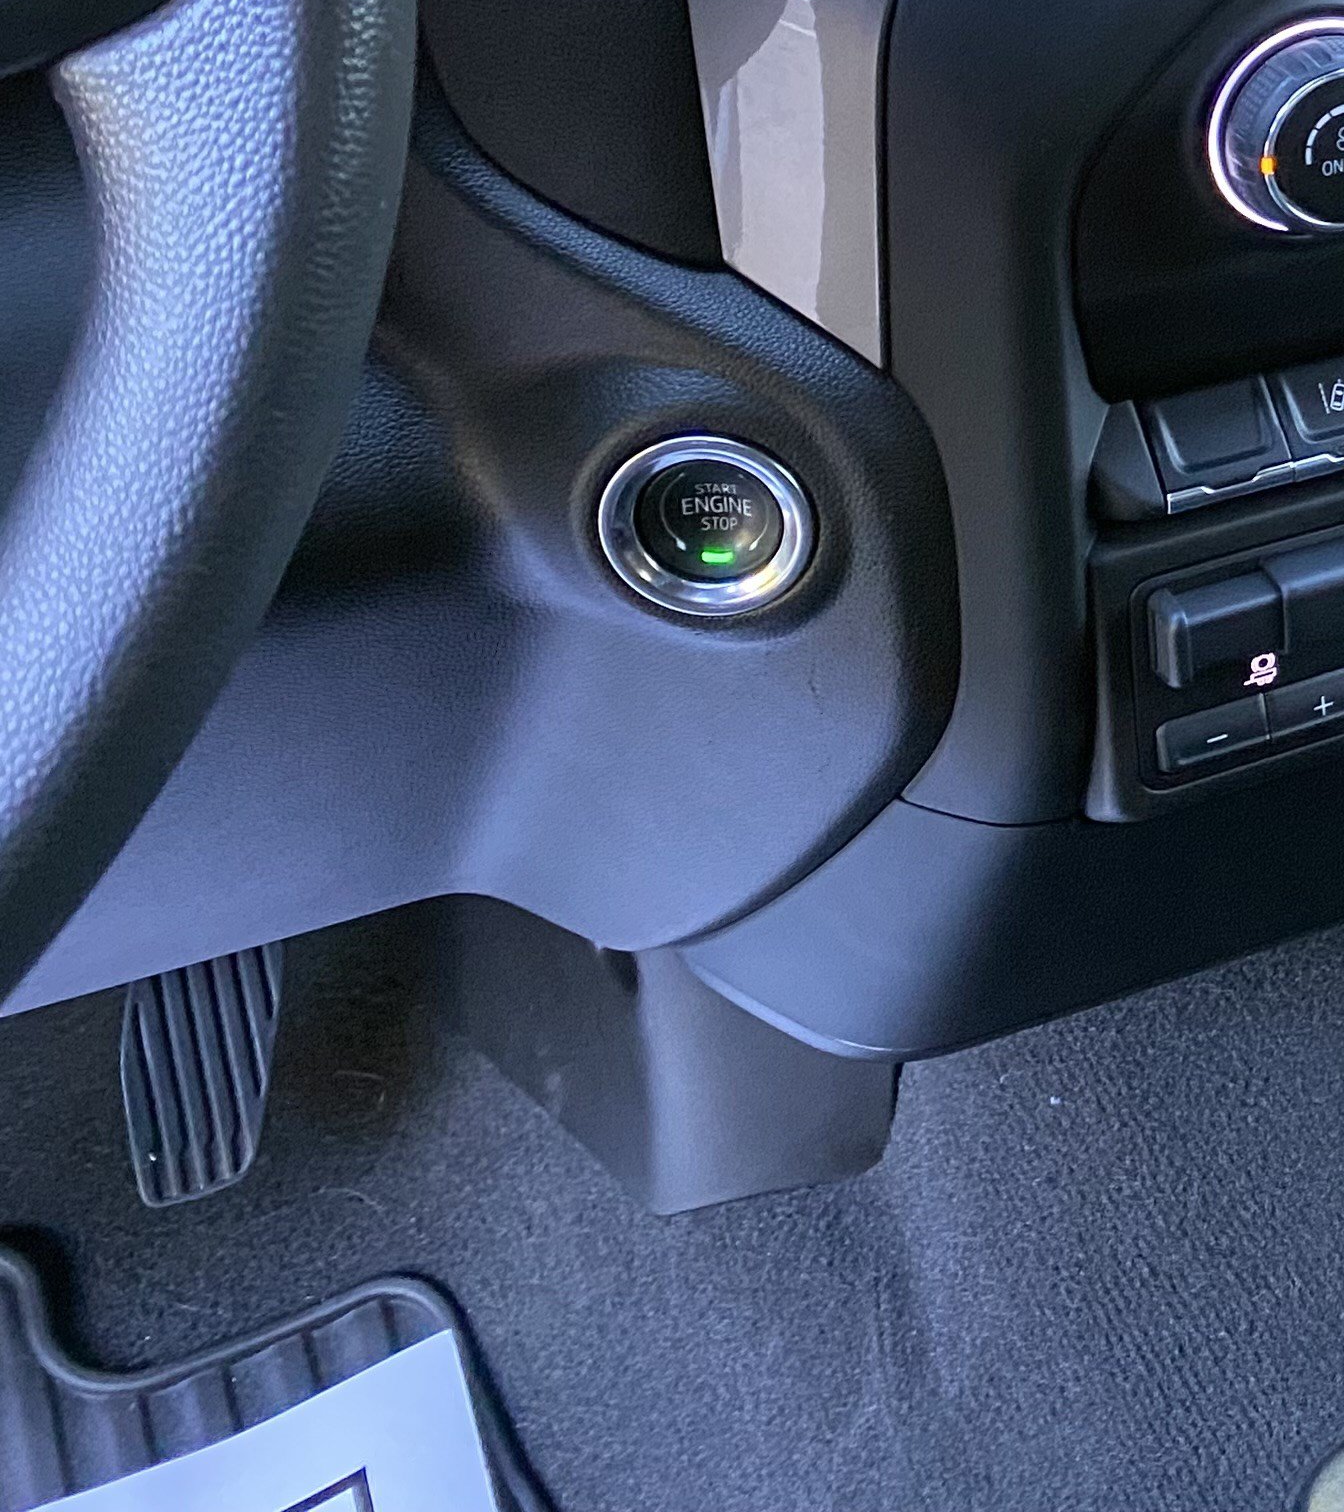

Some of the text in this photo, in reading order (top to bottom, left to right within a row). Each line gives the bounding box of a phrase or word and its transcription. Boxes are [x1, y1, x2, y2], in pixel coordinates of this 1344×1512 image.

[694, 483, 737, 495] START
[681, 496, 752, 517] ENGINE
[701, 516, 738, 531] STOP
